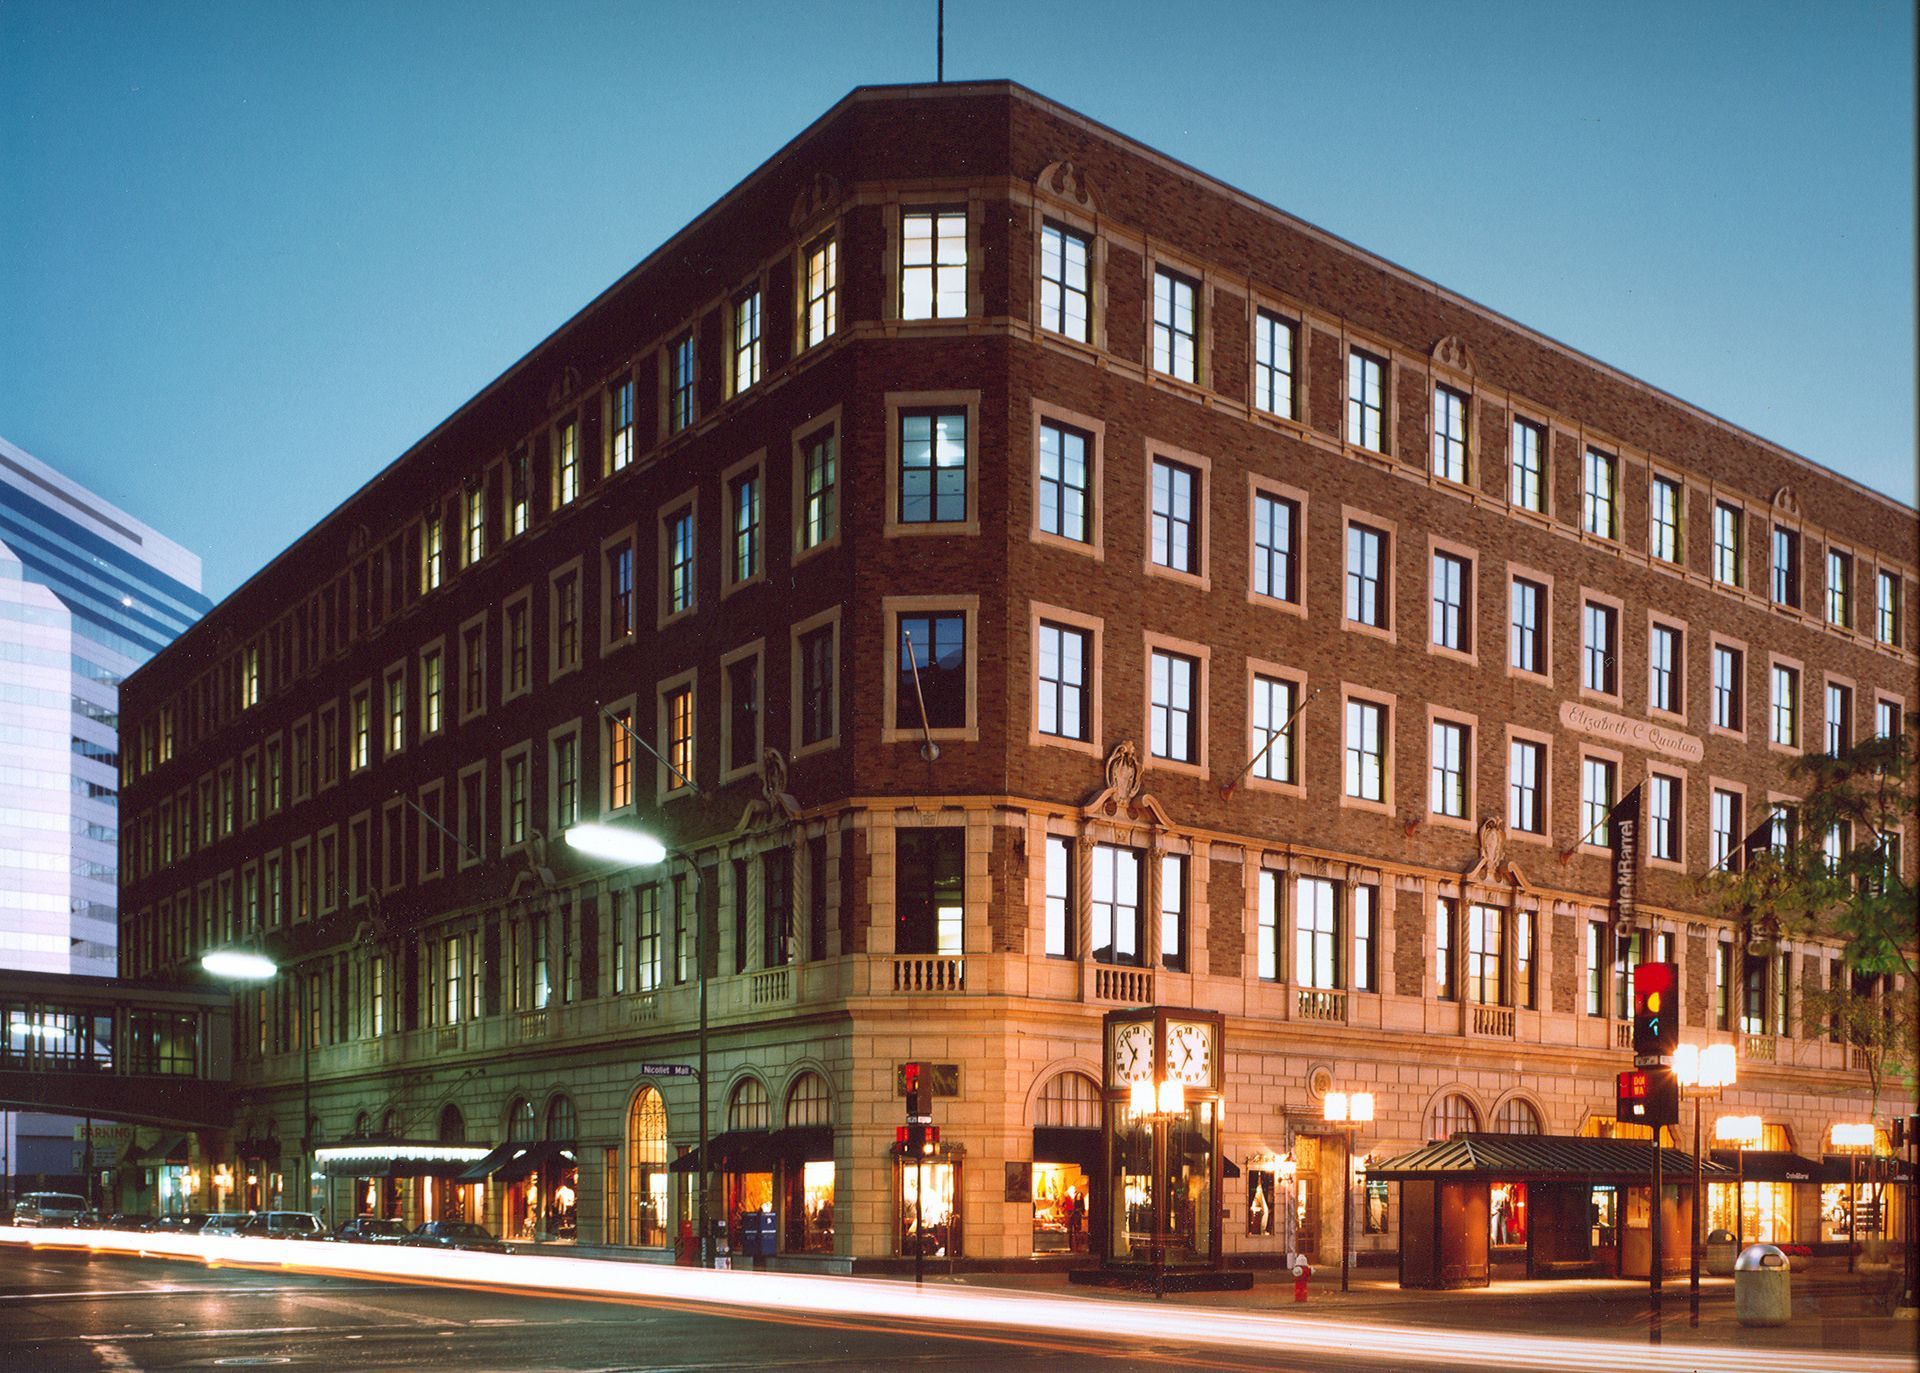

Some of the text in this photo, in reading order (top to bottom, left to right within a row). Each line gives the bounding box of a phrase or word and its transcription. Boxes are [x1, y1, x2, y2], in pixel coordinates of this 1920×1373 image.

[1633, 726, 1644, 739] C
[1616, 820, 1633, 938] Crate&Barrel
[644, 1066, 670, 1074] Nicollet
[81, 1128, 130, 1138] PARKING
